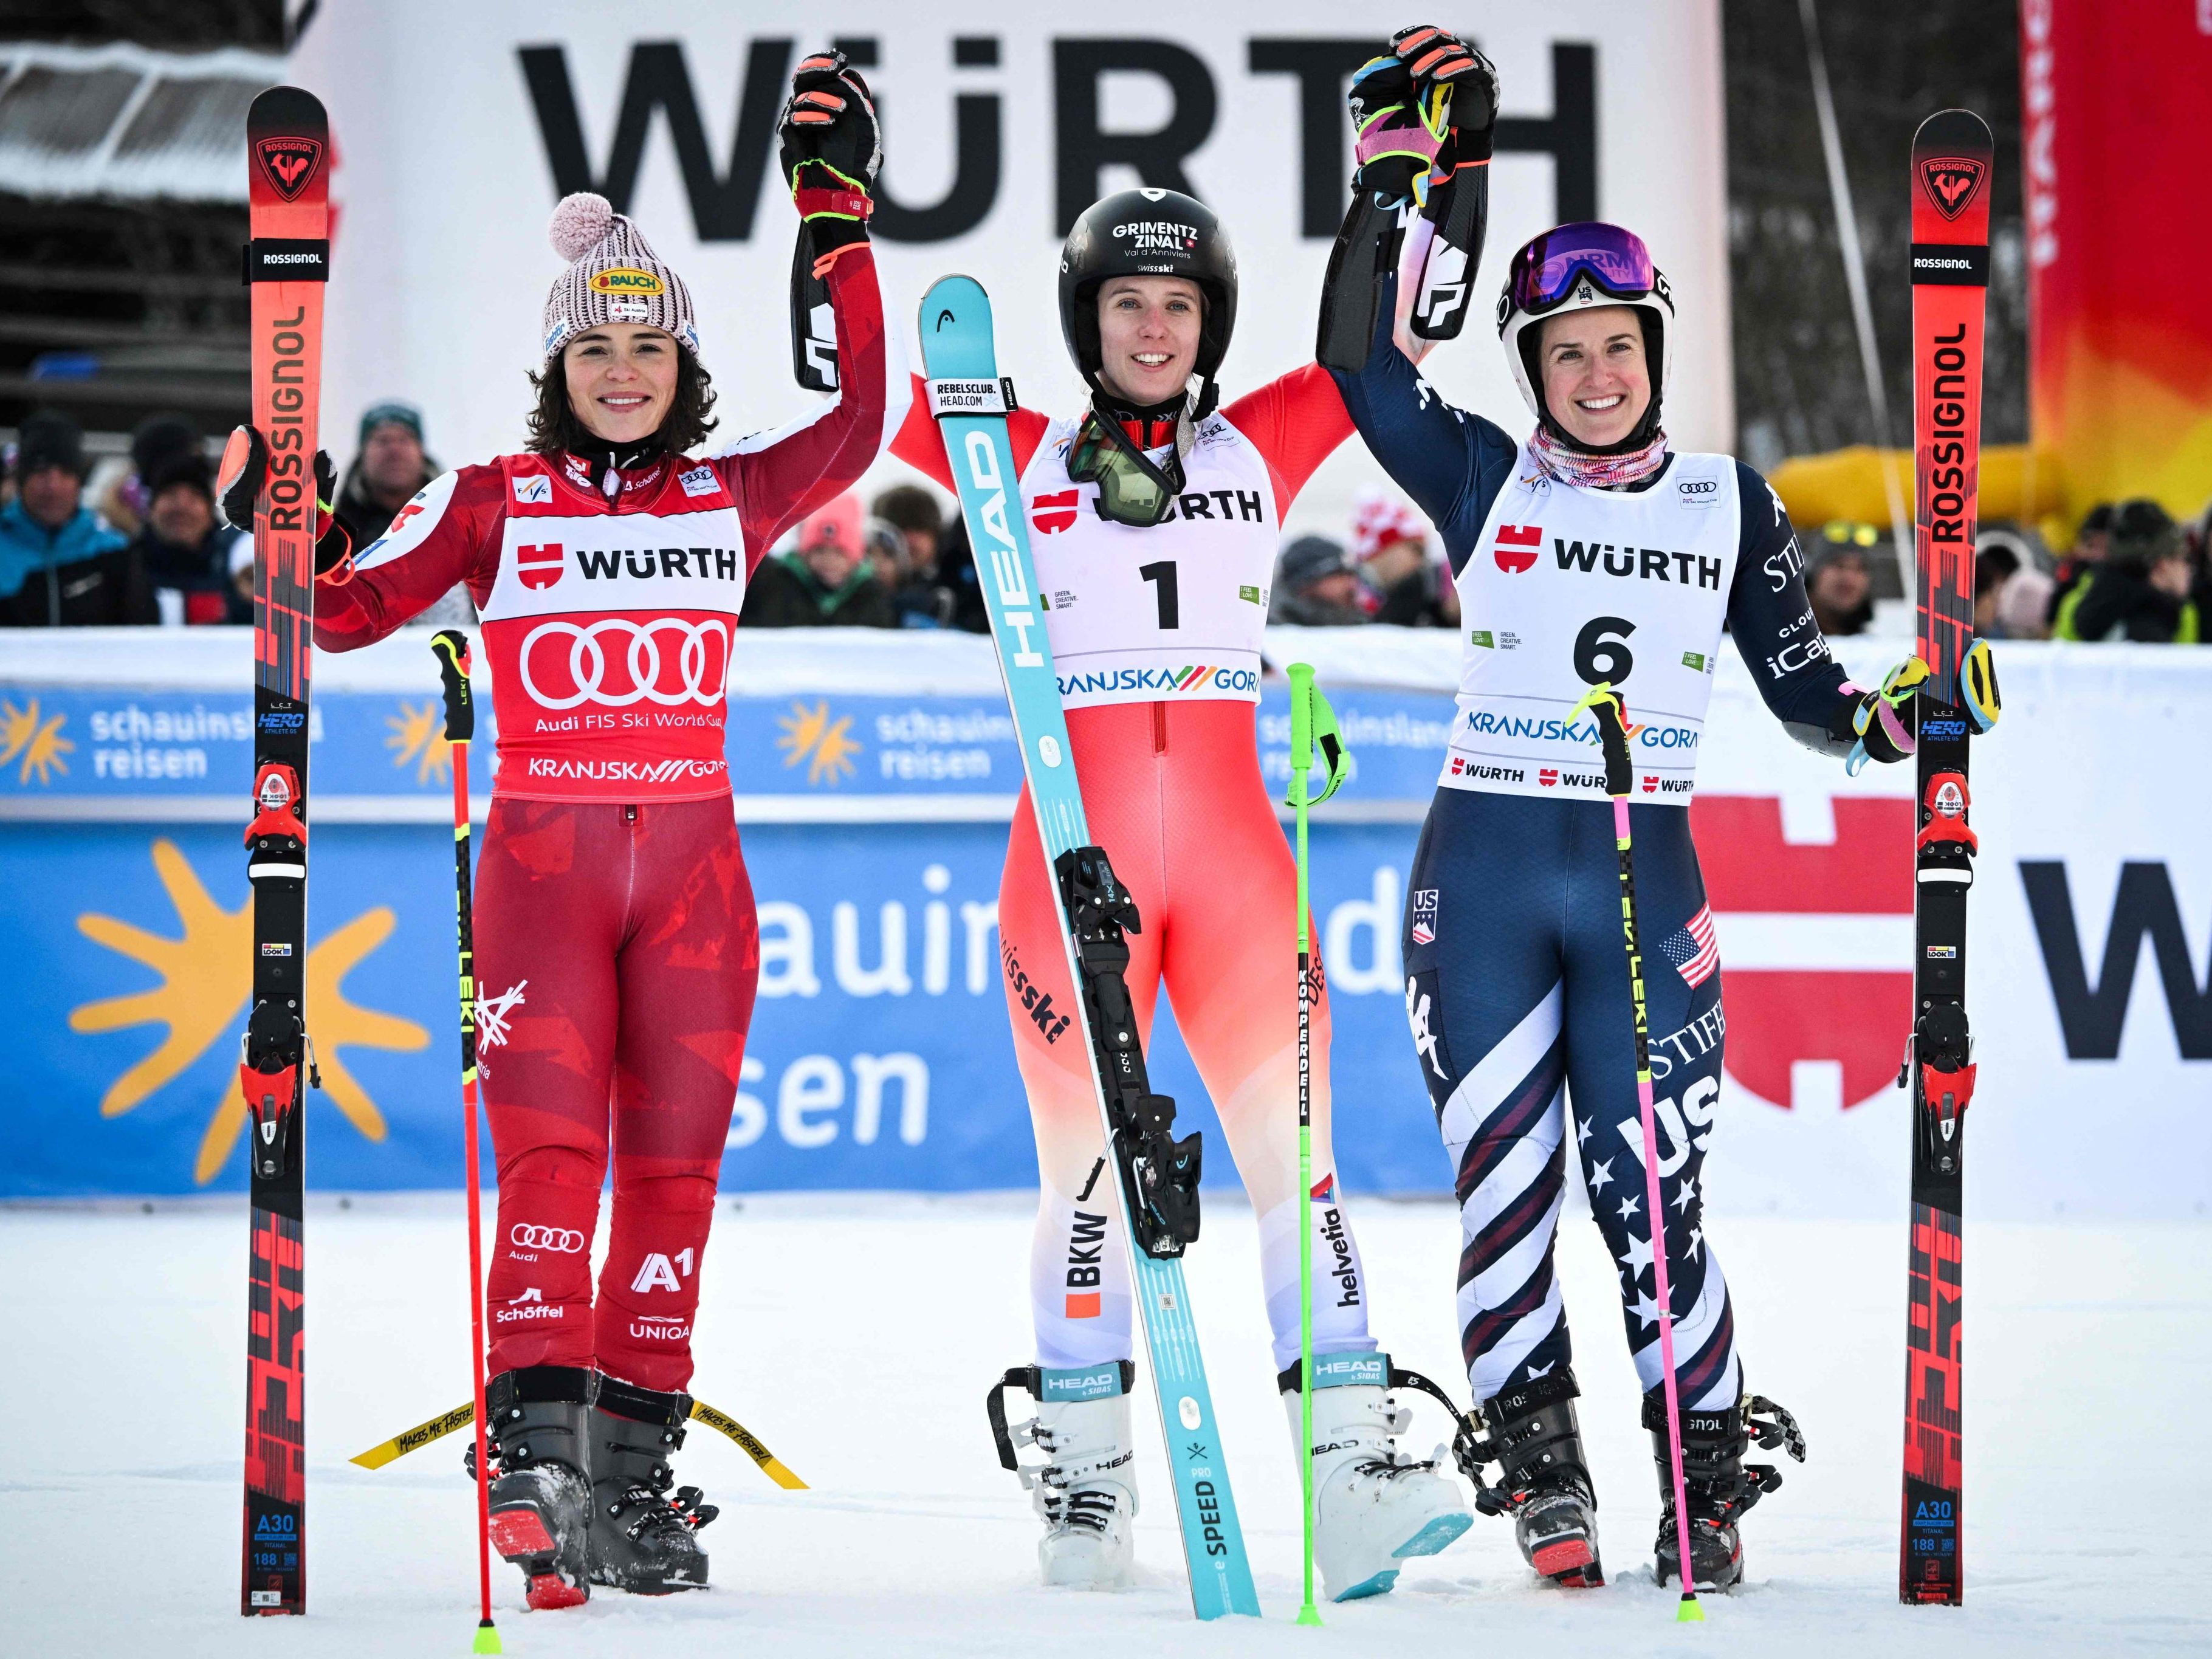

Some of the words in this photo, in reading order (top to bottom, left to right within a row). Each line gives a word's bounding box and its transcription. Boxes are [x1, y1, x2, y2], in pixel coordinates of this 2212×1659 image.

[266, 143, 313, 153] ROSSIGNOL
[1929, 162, 1976, 174] ROSSIGNOL
[1135, 235, 1183, 250] ZINAL
[263, 253, 322, 264] ROSSIGNOL
[1914, 258, 1972, 269] ROSSIGNOL
[610, 275, 656, 290] RAUCH
[545, 322, 565, 352] Eisbär
[938, 383, 996, 394] REBELSCLUB.
[1005, 380, 1014, 405] HEAD
[940, 396, 983, 407] HEAD.COM
[270, 306, 305, 531] ROSSIGNOL
[1931, 323, 1966, 543] ROSSIGNOL
[1091, 490, 1263, 524] RTH
[964, 430, 1045, 668] HEAD
[575, 548, 736, 581] WÜRTH
[1554, 538, 1722, 591] WÜRTH
[1138, 561, 1179, 630] 1
[1573, 616, 1637, 687] 6
[1056, 668, 1178, 696] RANJSKA
[258, 713, 304, 727] HERO
[535, 716, 579, 733] Audi
[586, 714, 615, 729] FIS
[622, 713, 649, 727] Ski
[654, 713, 704, 727] World
[1468, 711, 1602, 744] KRANJSKA
[1920, 721, 1966, 735] HERO
[528, 758, 658, 781] KRANJSKA
[1466, 763, 1524, 783] WÜRTH
[1562, 773, 1606, 789] WÜR
[1414, 891, 1437, 910] US
[458, 951, 475, 1032] LEKI
[1630, 955, 1648, 1034] LEKI
[1298, 970, 1308, 1116] KOMPERDELL
[509, 1251, 538, 1262] Audi
[1066, 1211, 1108, 1288] BKW
[1320, 1208, 1360, 1308] helvetia
[630, 1247, 695, 1293] A1
[496, 1306, 563, 1323] Schöffel
[630, 1323, 690, 1340] UNIQA
[1316, 1361, 1382, 1376] HEAD
[1356, 1372, 1381, 1381] SIDAS
[1049, 1373, 1113, 1389] HEAD
[1088, 1385, 1112, 1395] SIDAS
[698, 1407, 725, 1428] MAKES
[399, 1427, 429, 1451] MAKES
[1192, 1468, 1211, 1479] PRO
[1195, 1480, 1227, 1556] SPEED
[1915, 1501, 1952, 1519] A30
[257, 1514, 294, 1533] A30
[1912, 1539, 1935, 1551] 188
[254, 1553, 276, 1566] 188
